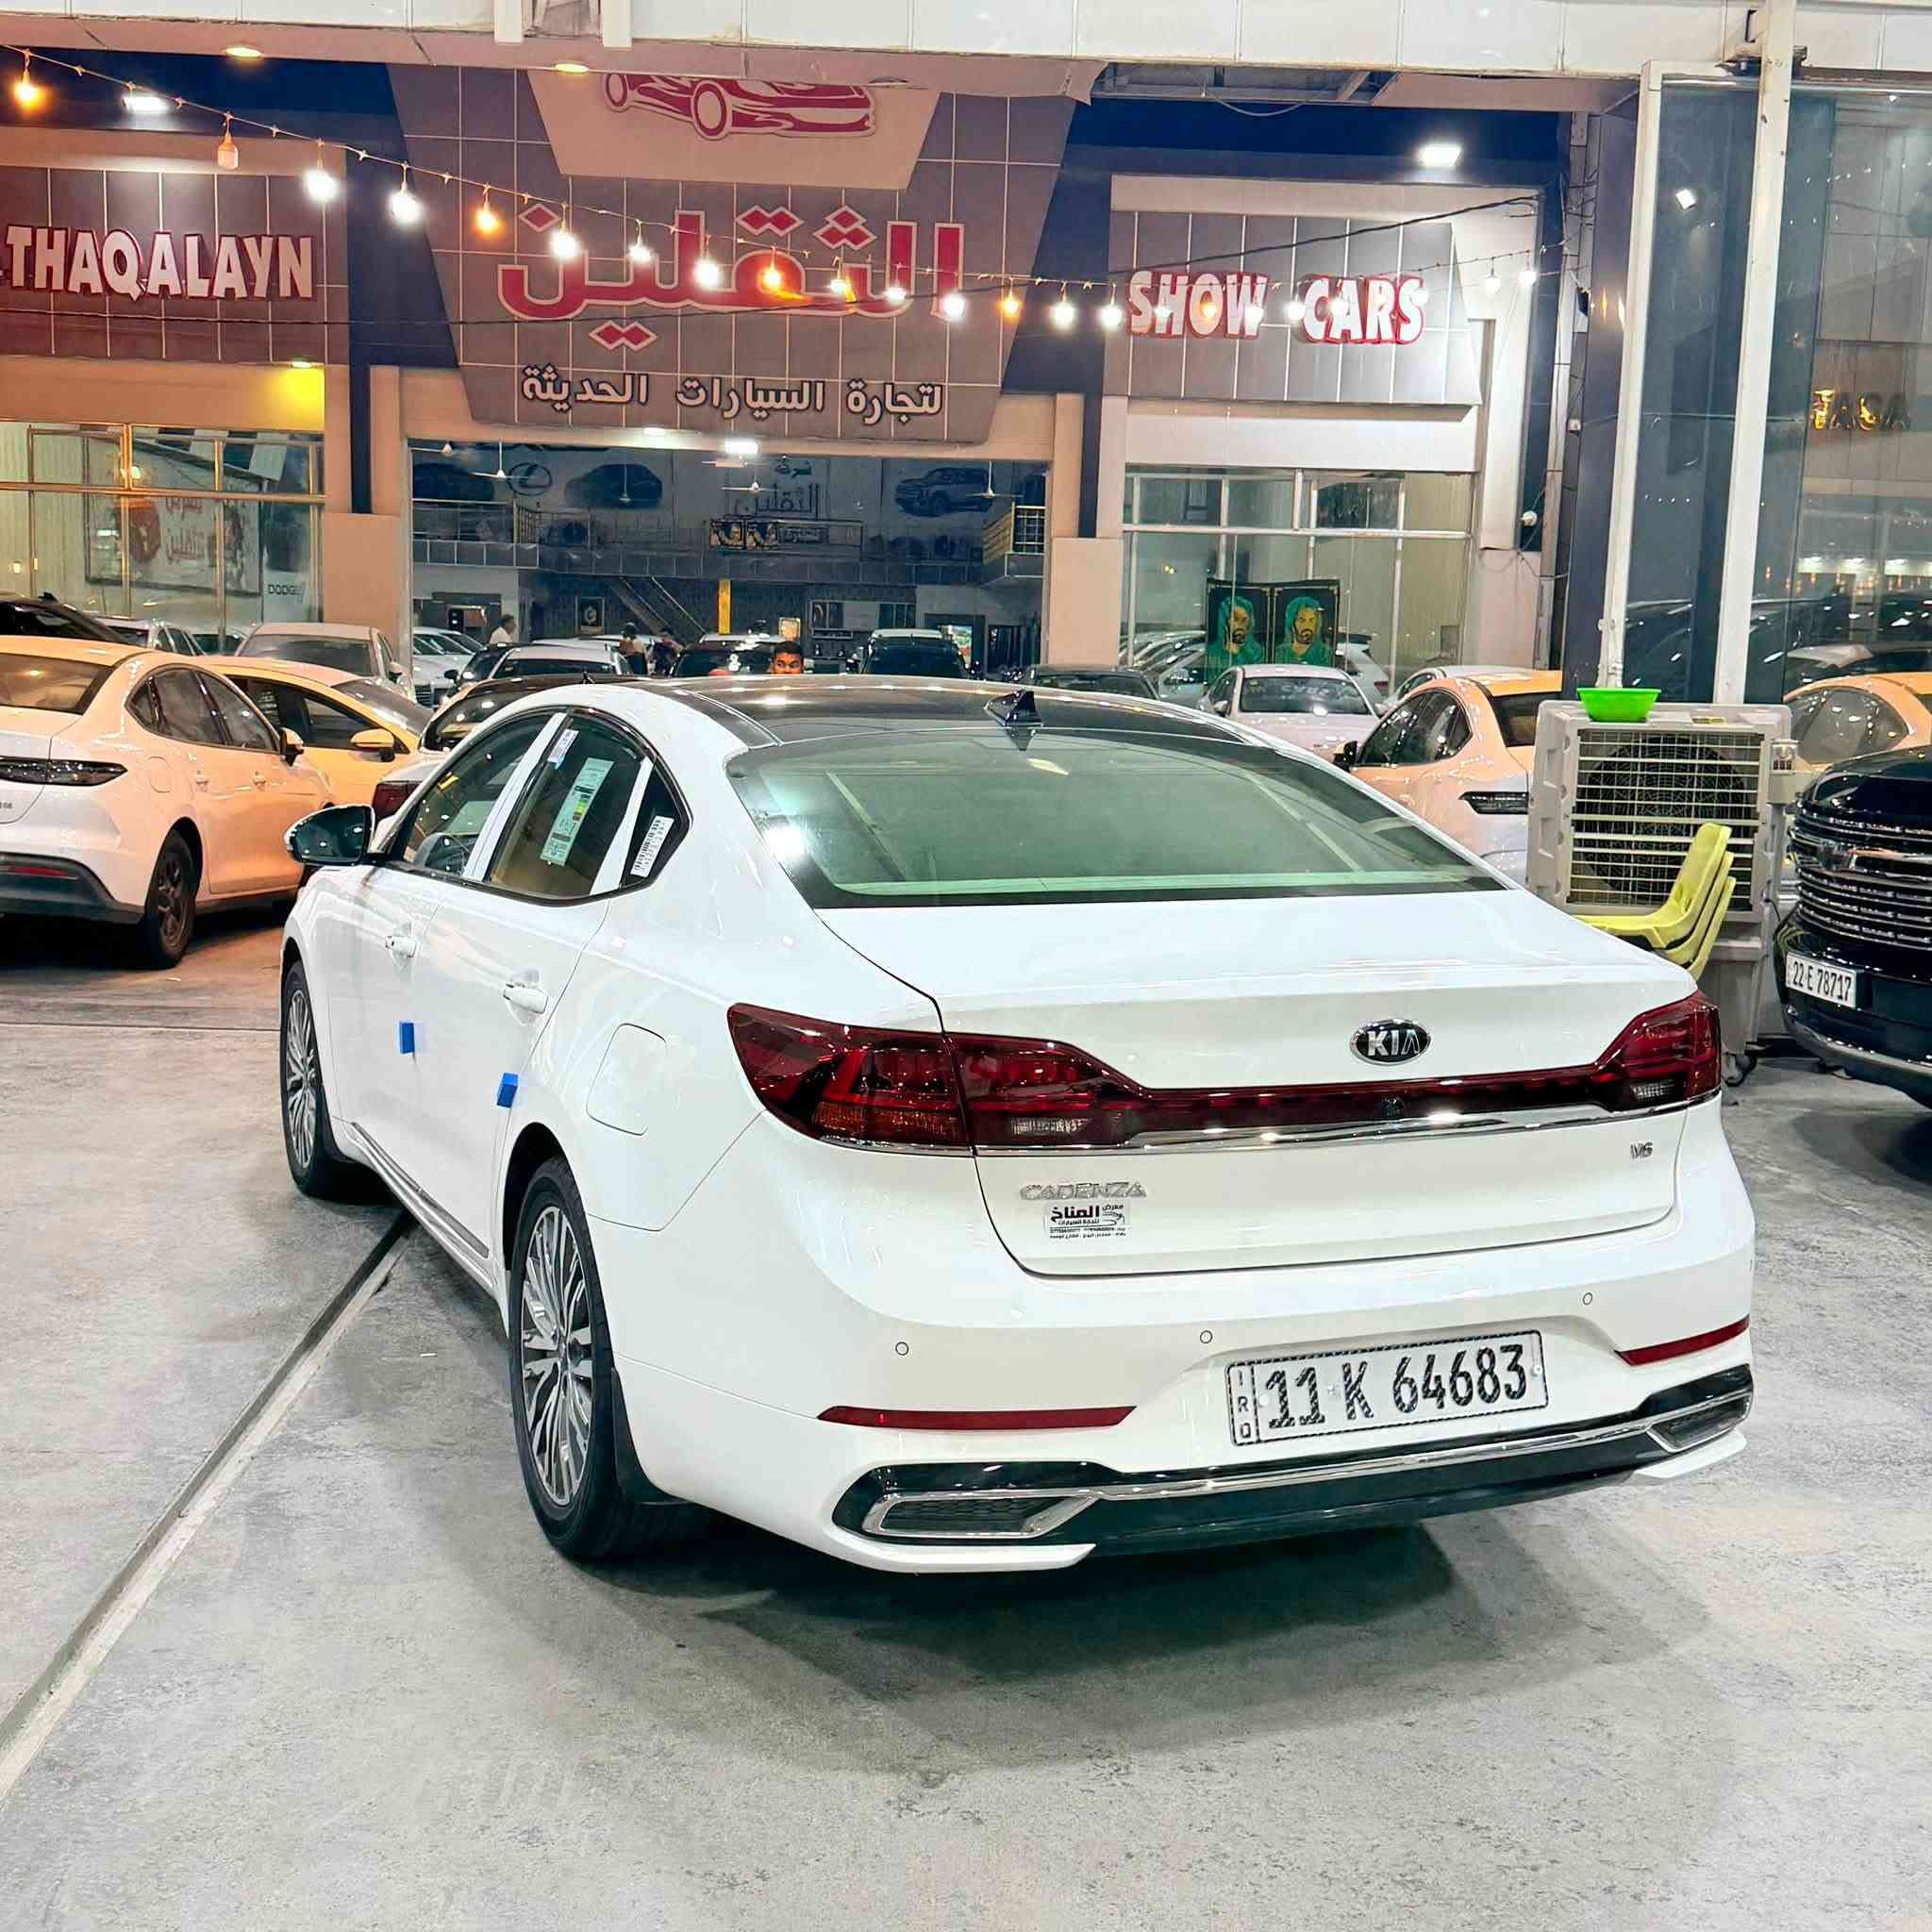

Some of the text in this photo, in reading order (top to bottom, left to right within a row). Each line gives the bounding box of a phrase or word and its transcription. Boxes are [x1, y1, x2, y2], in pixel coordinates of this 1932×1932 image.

[6, 224, 316, 301] THAQALAYN
[497, 203, 965, 352] الثقلين
[1128, 270, 1424, 343] SHOW CARS
[521, 363, 944, 425] لتجارة السيارات الحديثة
[1792, 960, 1804, 987] 22
[1807, 965, 1813, 991] E
[1817, 969, 1852, 1001] 78717
[1367, 1029, 1420, 1057] KIA
[1630, 1141, 1653, 1159] V6
[1020, 1181, 1147, 1201] CADENZA
[1266, 1344, 1527, 1428] 11 K 64683
